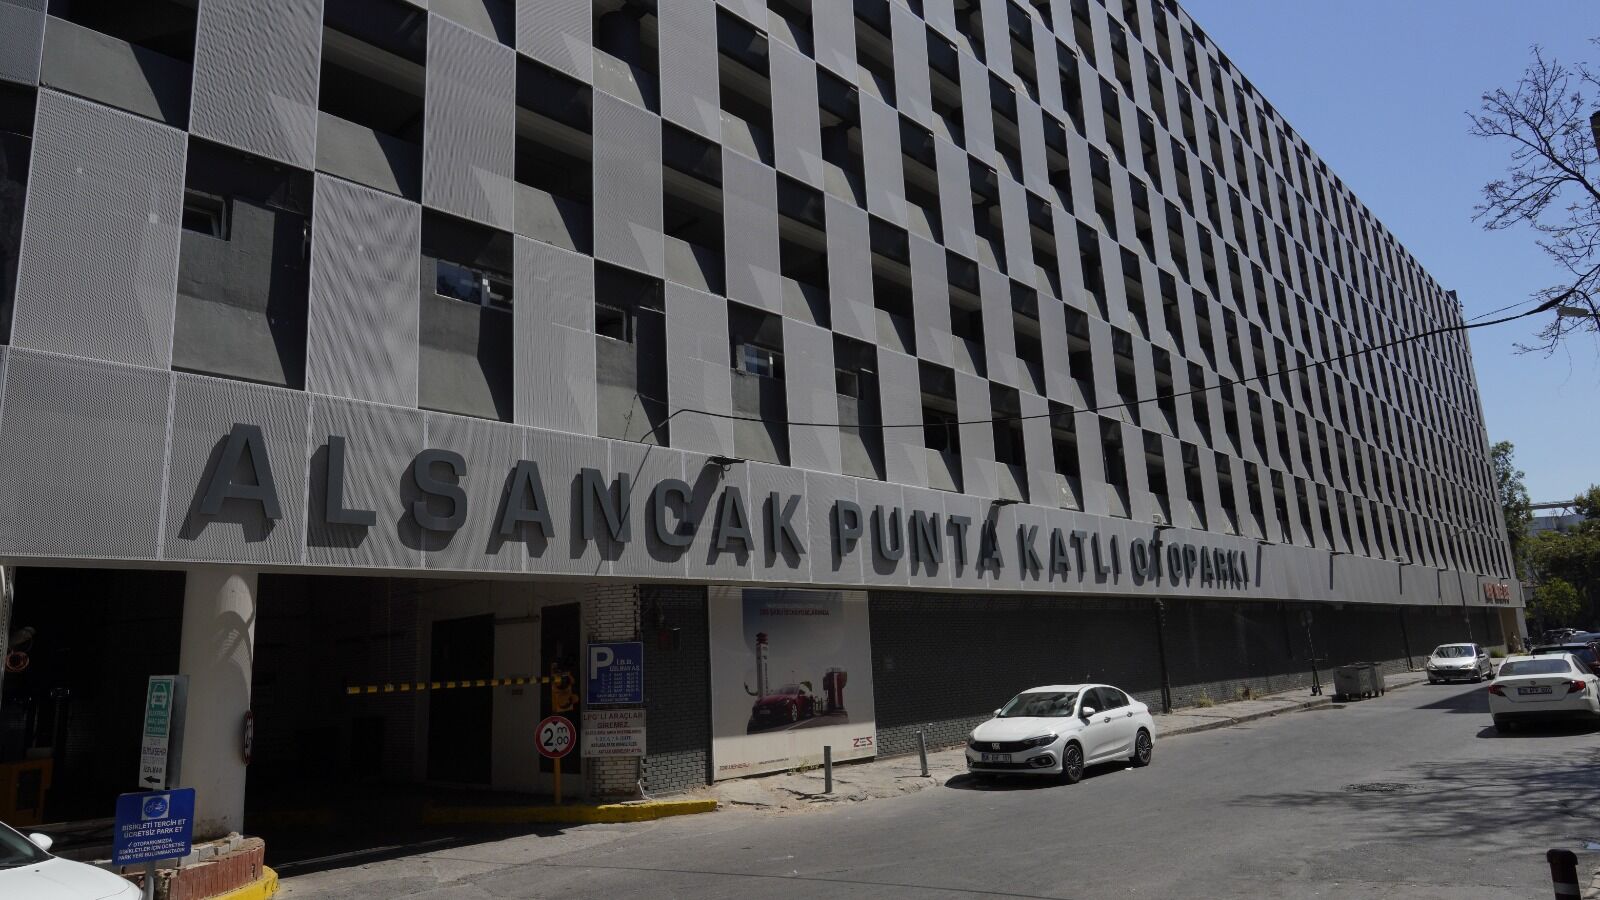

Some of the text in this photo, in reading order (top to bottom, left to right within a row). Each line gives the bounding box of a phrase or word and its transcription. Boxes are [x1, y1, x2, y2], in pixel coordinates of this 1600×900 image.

[199, 422, 1249, 582] ALSANCAK PUNTA KATLI OTOPARKI
[590, 646, 614, 680] P
[543, 728, 554, 747] 2
[154, 818, 177, 828] TERCİH
[177, 818, 187, 826] ET
[123, 829, 155, 839] ÜCRETSİZ
[156, 827, 174, 835] PARK
